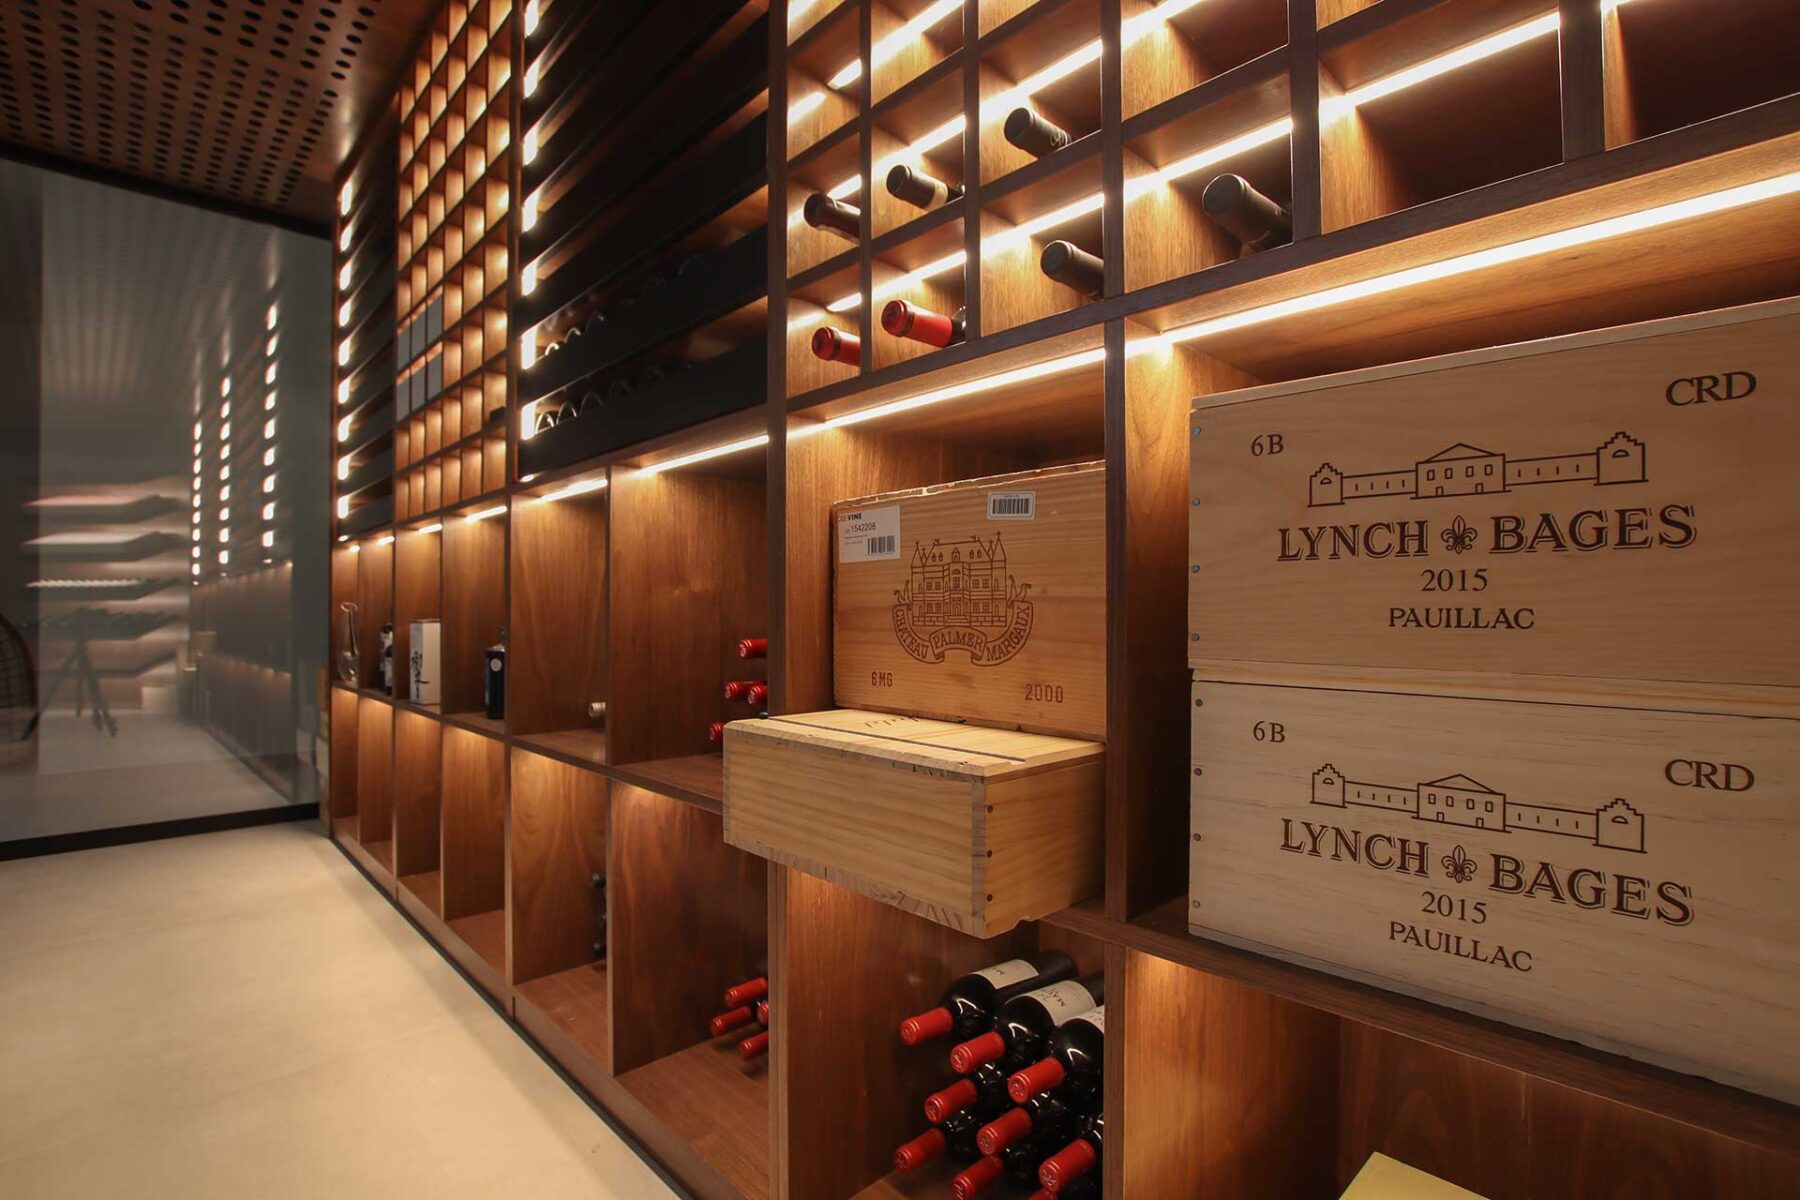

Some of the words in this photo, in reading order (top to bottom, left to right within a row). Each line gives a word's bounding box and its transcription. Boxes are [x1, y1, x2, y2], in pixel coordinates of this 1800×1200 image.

[1666, 371, 1757, 407] CRD
[1251, 434, 1285, 457] 6B
[847, 512, 863, 521] VINE
[1277, 520, 1430, 561] LYNCH
[1488, 504, 1698, 555] BAGES
[1420, 567, 1489, 593] 2015
[1388, 606, 1536, 630] PAUILLAC
[932, 629, 984, 653] PALMER
[985, 605, 1031, 662] MARGAUX
[871, 670, 894, 688] 6MG
[1024, 683, 1064, 704] 2000
[1252, 720, 1286, 744] 6B
[1664, 758, 1756, 793] CRD
[1279, 817, 1431, 878] LYNCH
[1488, 853, 1695, 928] BAGES
[1420, 890, 1489, 925] 2015
[1388, 920, 1533, 973] PAUILLAC
